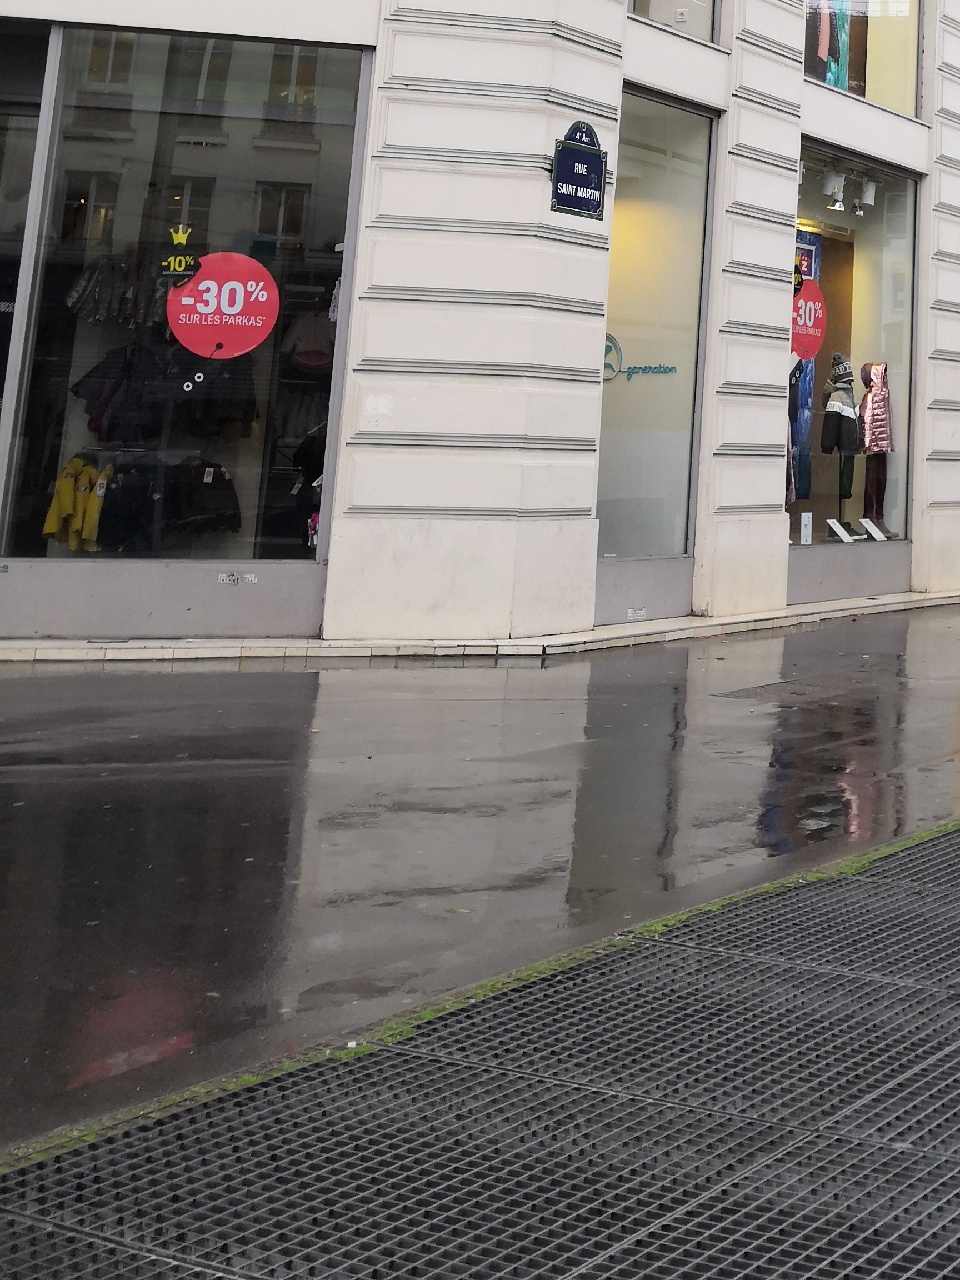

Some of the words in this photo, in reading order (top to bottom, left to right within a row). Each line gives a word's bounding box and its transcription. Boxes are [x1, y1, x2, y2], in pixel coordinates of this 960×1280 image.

[574, 163, 588, 175] RUE
[557, 182, 576, 196] SAINT
[577, 186, 600, 201] MARTIN
[161, 255, 194, 271] -10%
[181, 280, 268, 315] -30%
[179, 313, 200, 325] SUR
[202, 314, 221, 325] LES
[792, 299, 822, 327] -30%
